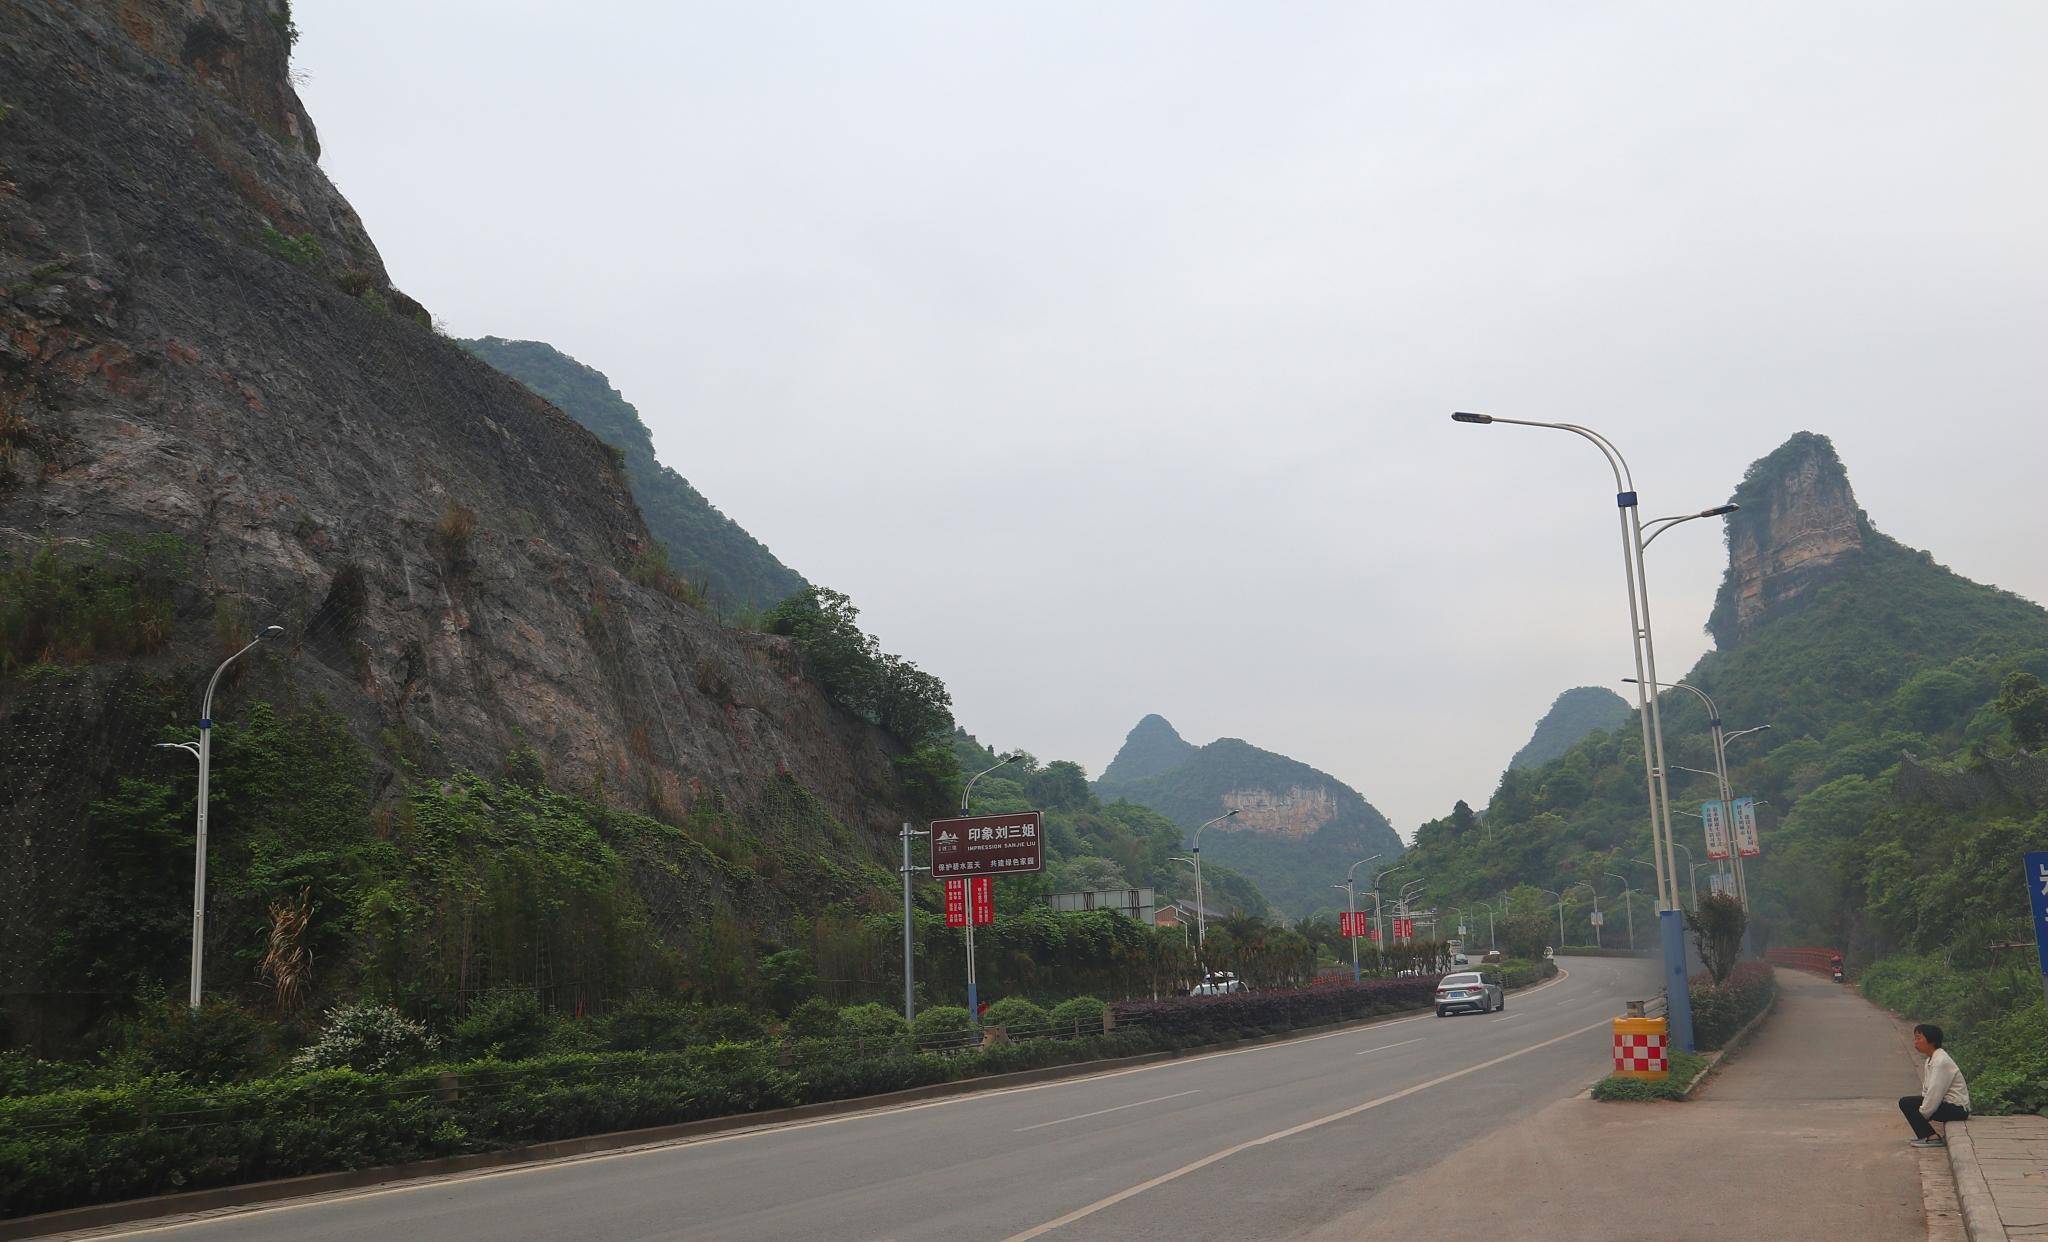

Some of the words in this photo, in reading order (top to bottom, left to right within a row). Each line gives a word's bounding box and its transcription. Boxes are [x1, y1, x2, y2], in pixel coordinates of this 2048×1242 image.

[968, 824, 1036, 842] 印象刘三姐
[938, 861, 981, 871] 保护碧水蓝天
[990, 857, 1034, 867] 共建绿色家园
